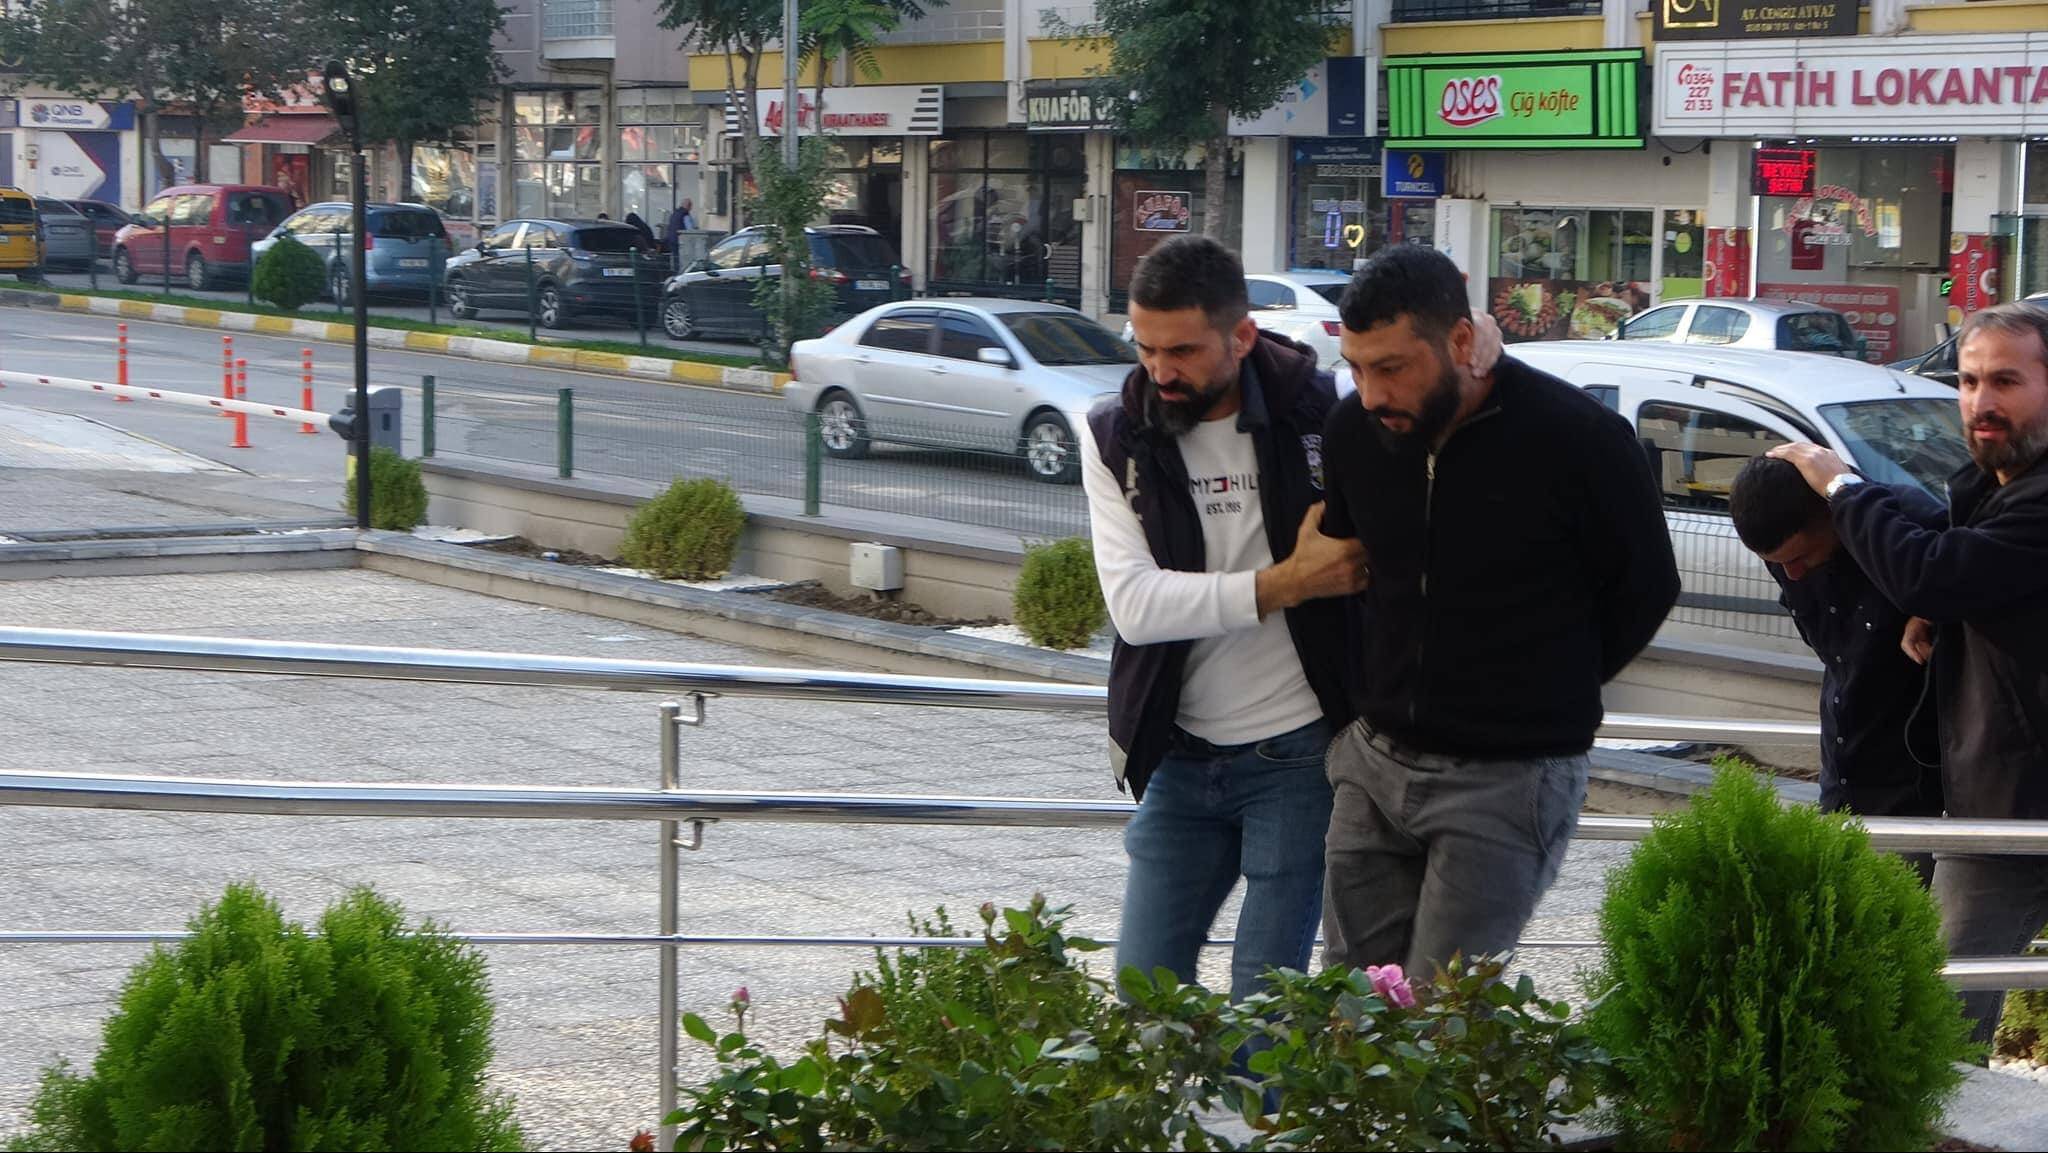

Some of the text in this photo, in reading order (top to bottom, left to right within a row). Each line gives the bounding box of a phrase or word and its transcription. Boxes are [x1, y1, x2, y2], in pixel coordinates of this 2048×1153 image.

[1686, 73, 1714, 86] 0364
[1722, 61, 1837, 108] FATİH
[1689, 86, 1710, 98] 227
[1510, 90, 1534, 118] Çiğ
[1538, 88, 1580, 117] köfte
[51, 104, 82, 116] QNB
